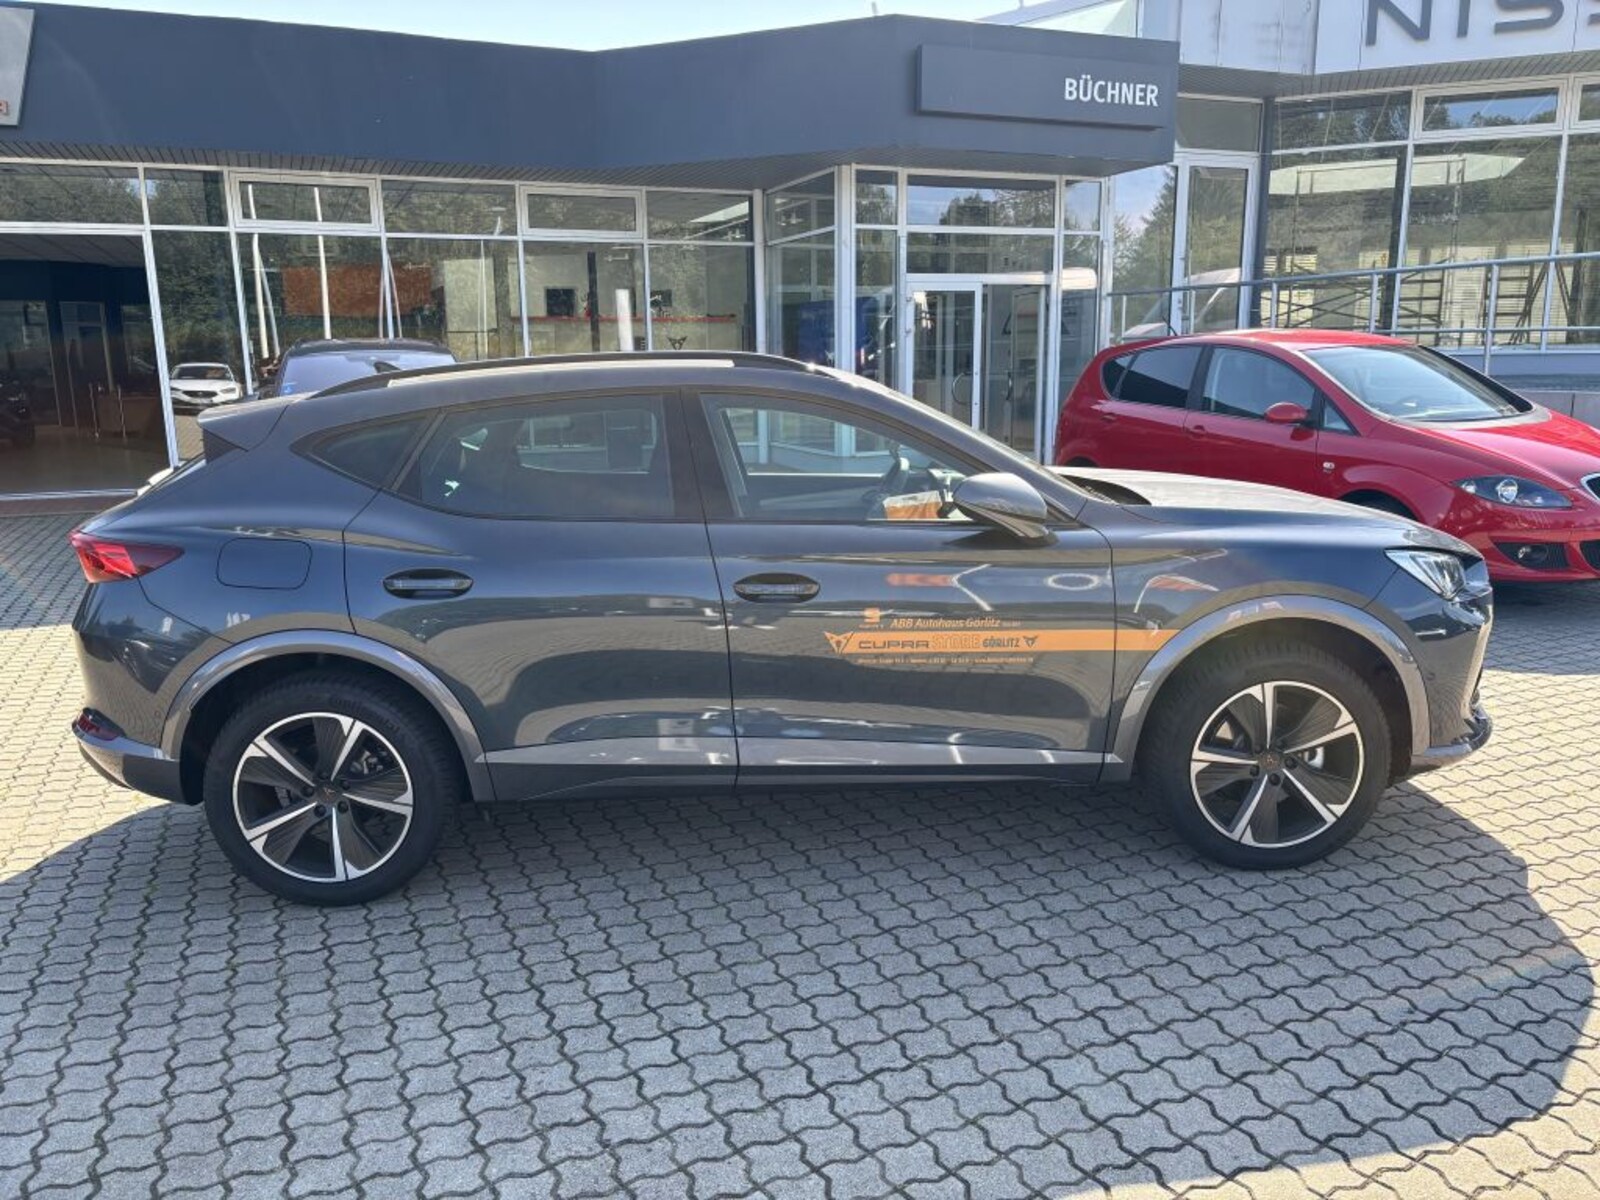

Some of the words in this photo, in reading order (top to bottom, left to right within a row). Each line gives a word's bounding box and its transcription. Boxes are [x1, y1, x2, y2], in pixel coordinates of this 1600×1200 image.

[1366, 0, 1600, 47] NIS
[1064, 74, 1159, 107] BÜCHNER
[915, 617, 964, 629] Autohaus
[965, 616, 1000, 628] Görlitz
[858, 640, 930, 649] CUPRA
